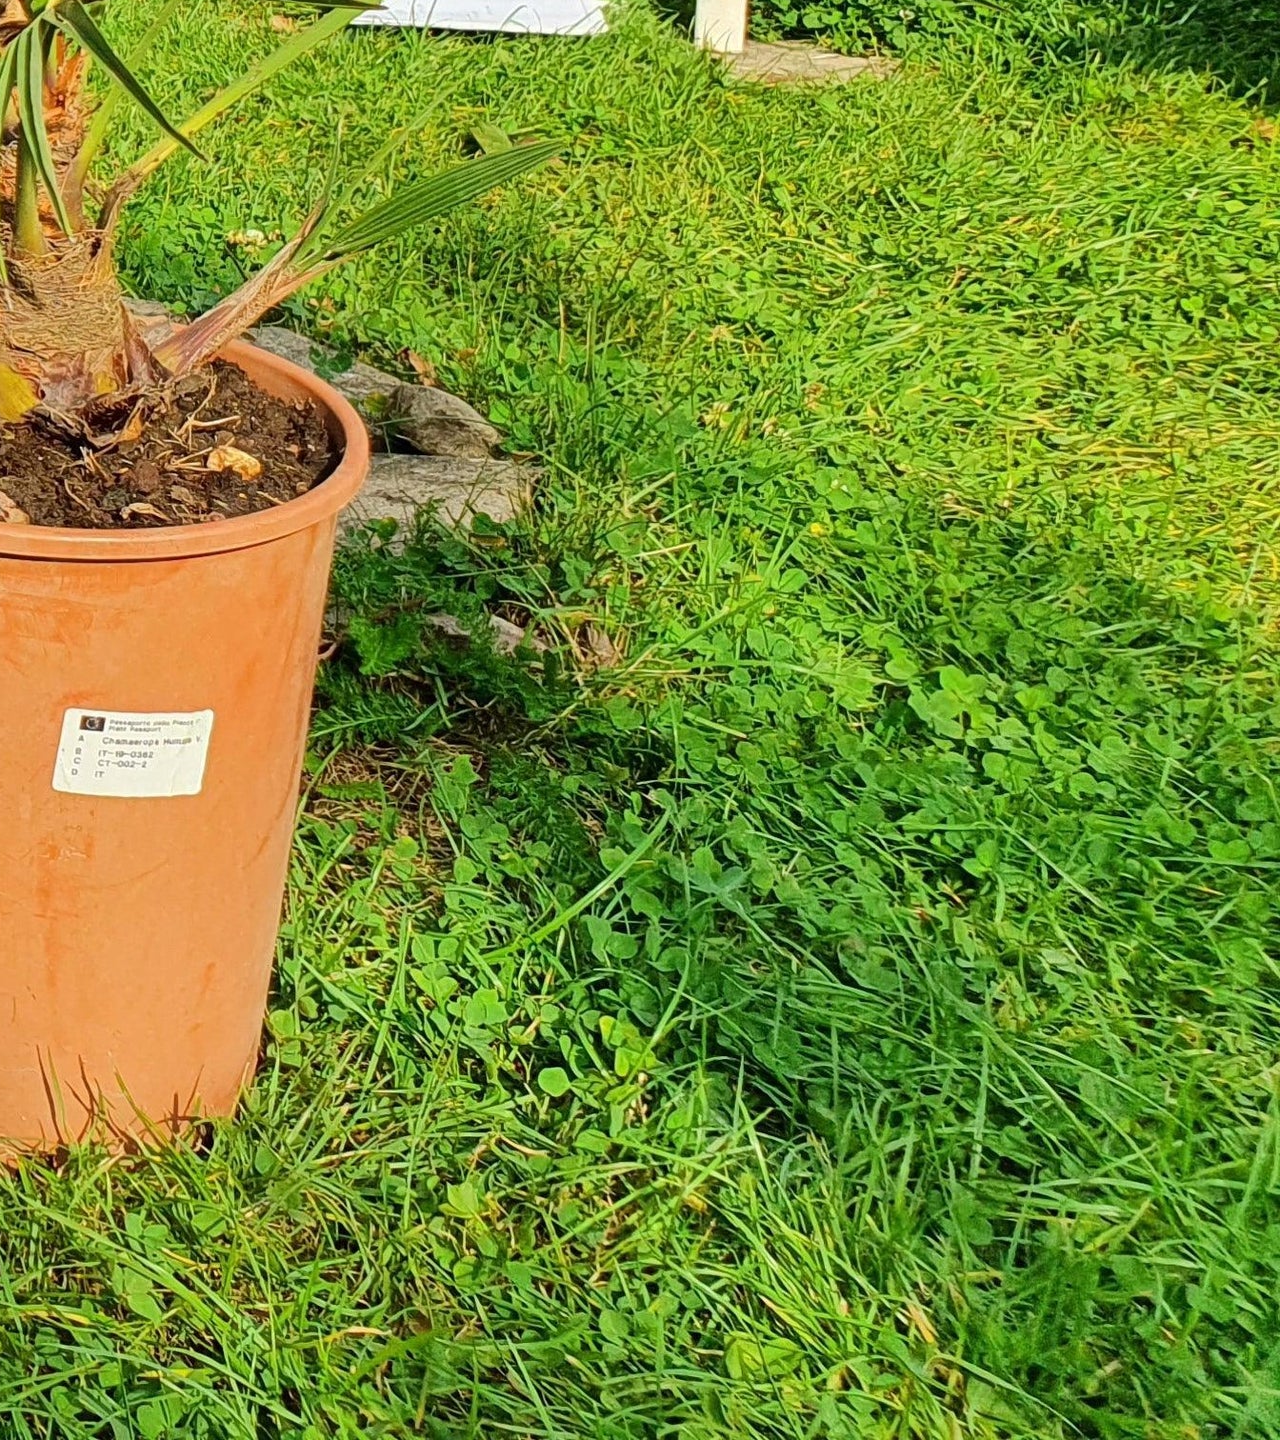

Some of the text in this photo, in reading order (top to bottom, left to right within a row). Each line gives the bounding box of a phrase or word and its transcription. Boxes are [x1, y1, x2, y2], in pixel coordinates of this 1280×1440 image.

[102, 736, 159, 747] Chamaerops
[75, 747, 82, 755] B
[97, 759, 148, 768] CT-002-2
[94, 770, 105, 778] IT
